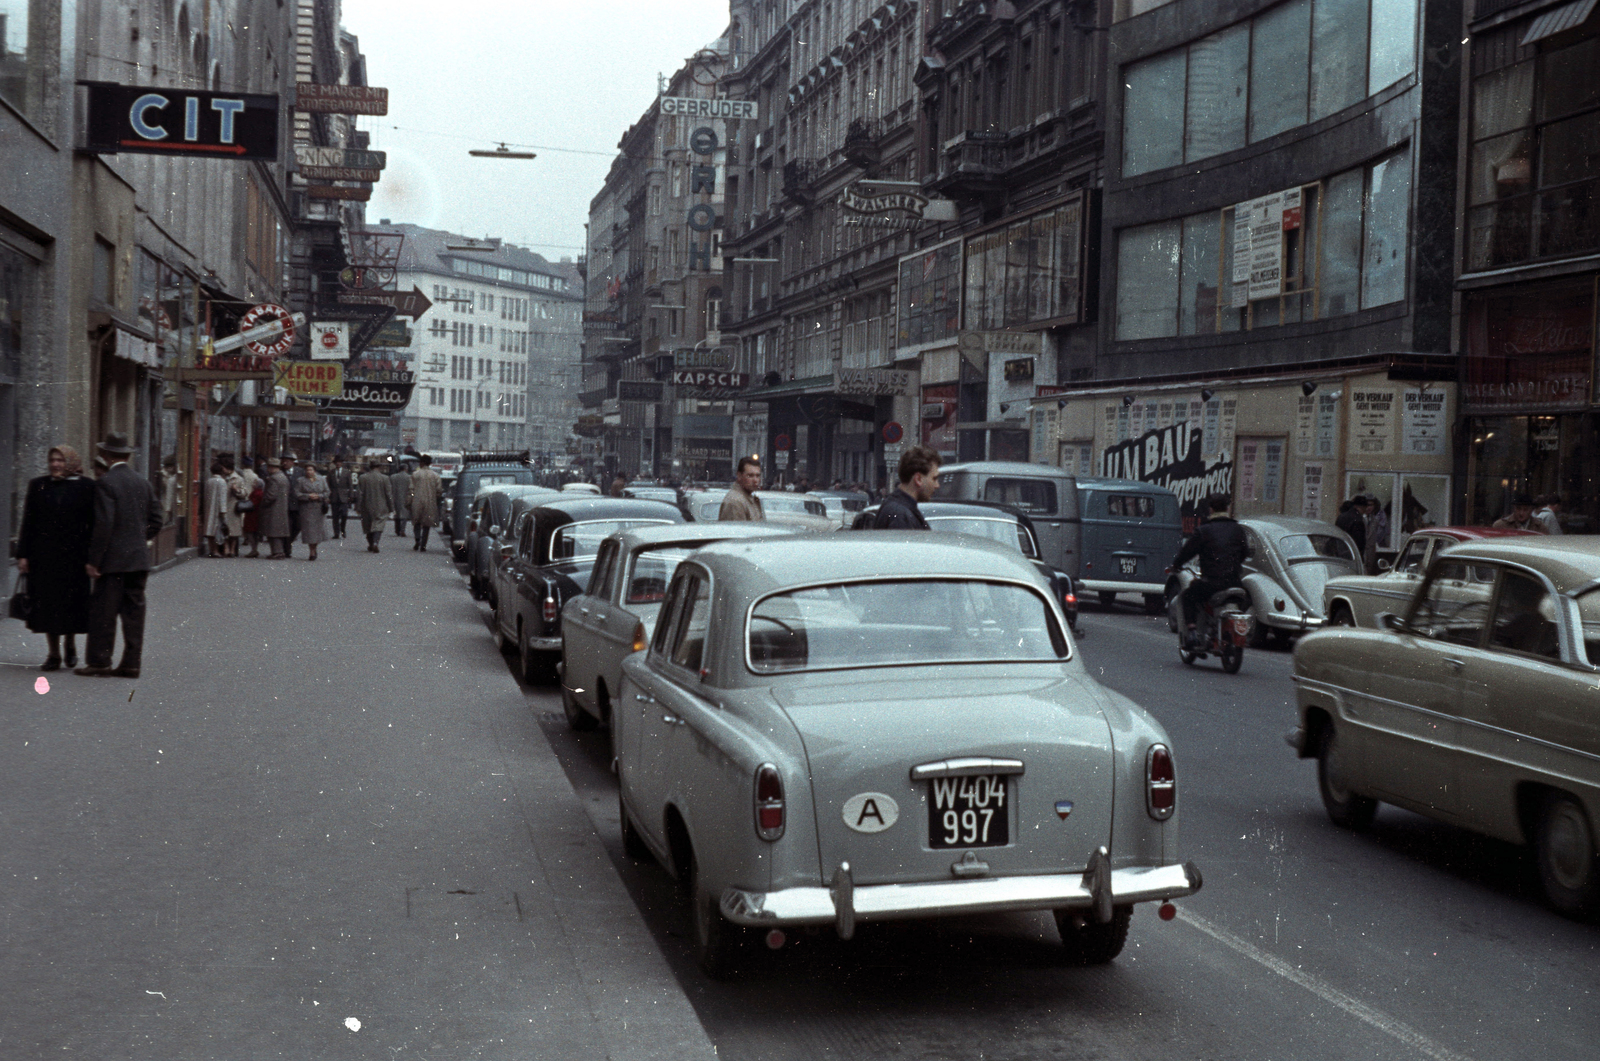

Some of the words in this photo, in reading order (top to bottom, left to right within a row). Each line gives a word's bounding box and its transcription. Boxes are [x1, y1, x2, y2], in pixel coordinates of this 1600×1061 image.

[299, 83, 317, 95] DIE
[320, 85, 361, 98] MARKE
[365, 87, 385, 99] MIT
[299, 99, 385, 113] STOFFGARANTIE
[129, 93, 245, 144] CIT
[302, 166, 378, 179] ATMUNGSAKTIV
[243, 303, 285, 328] TABAK
[316, 326, 343, 334] NEON
[252, 332, 293, 355] TRAFIK
[673, 371, 741, 386] KAPSCH
[1354, 392, 1365, 402] DER
[1366, 392, 1394, 402] VERKAUF
[1371, 402, 1391, 411] WEITER
[1422, 403, 1442, 412] WEITER
[933, 775, 1005, 810] W404
[856, 798, 886, 827] A
[942, 808, 995, 845] 997
